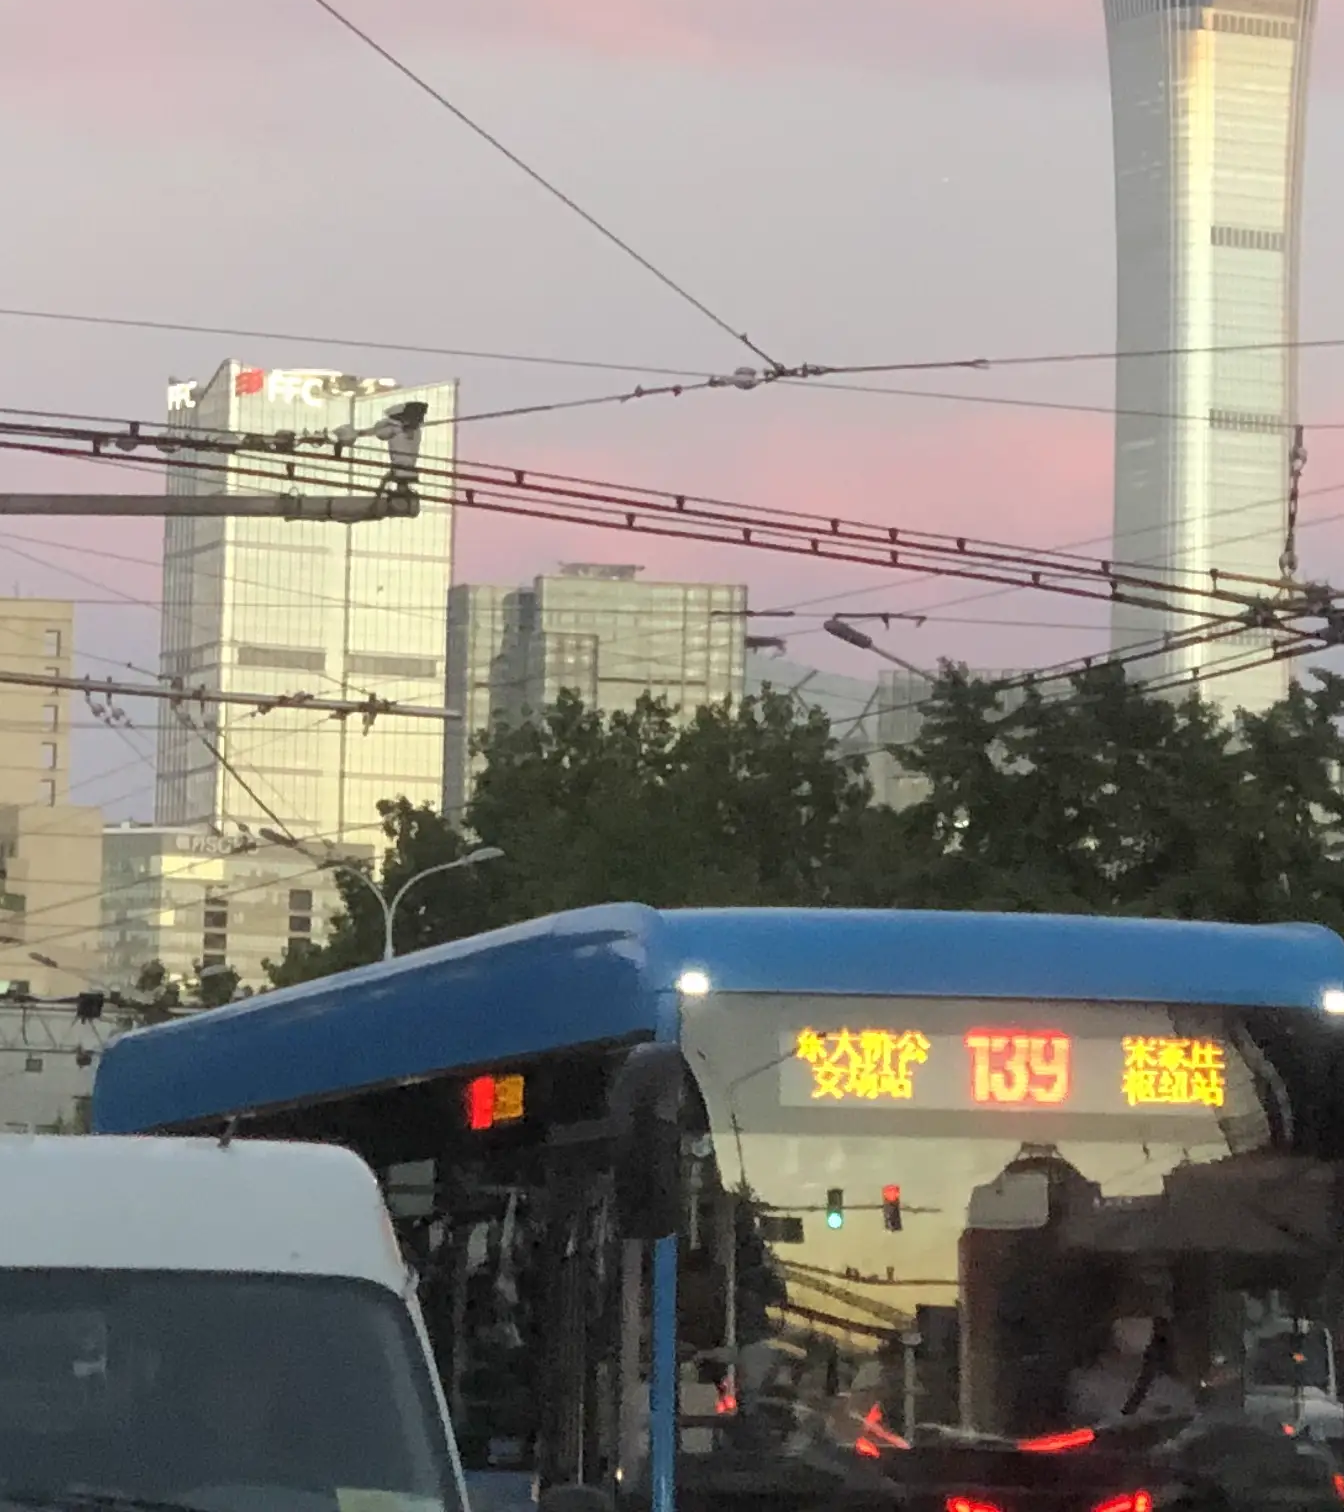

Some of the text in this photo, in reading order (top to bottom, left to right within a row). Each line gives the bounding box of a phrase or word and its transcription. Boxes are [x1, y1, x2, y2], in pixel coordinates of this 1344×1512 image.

[965, 1031, 1071, 1104] 139
[1121, 1068, 1225, 1106] 枢纽站
